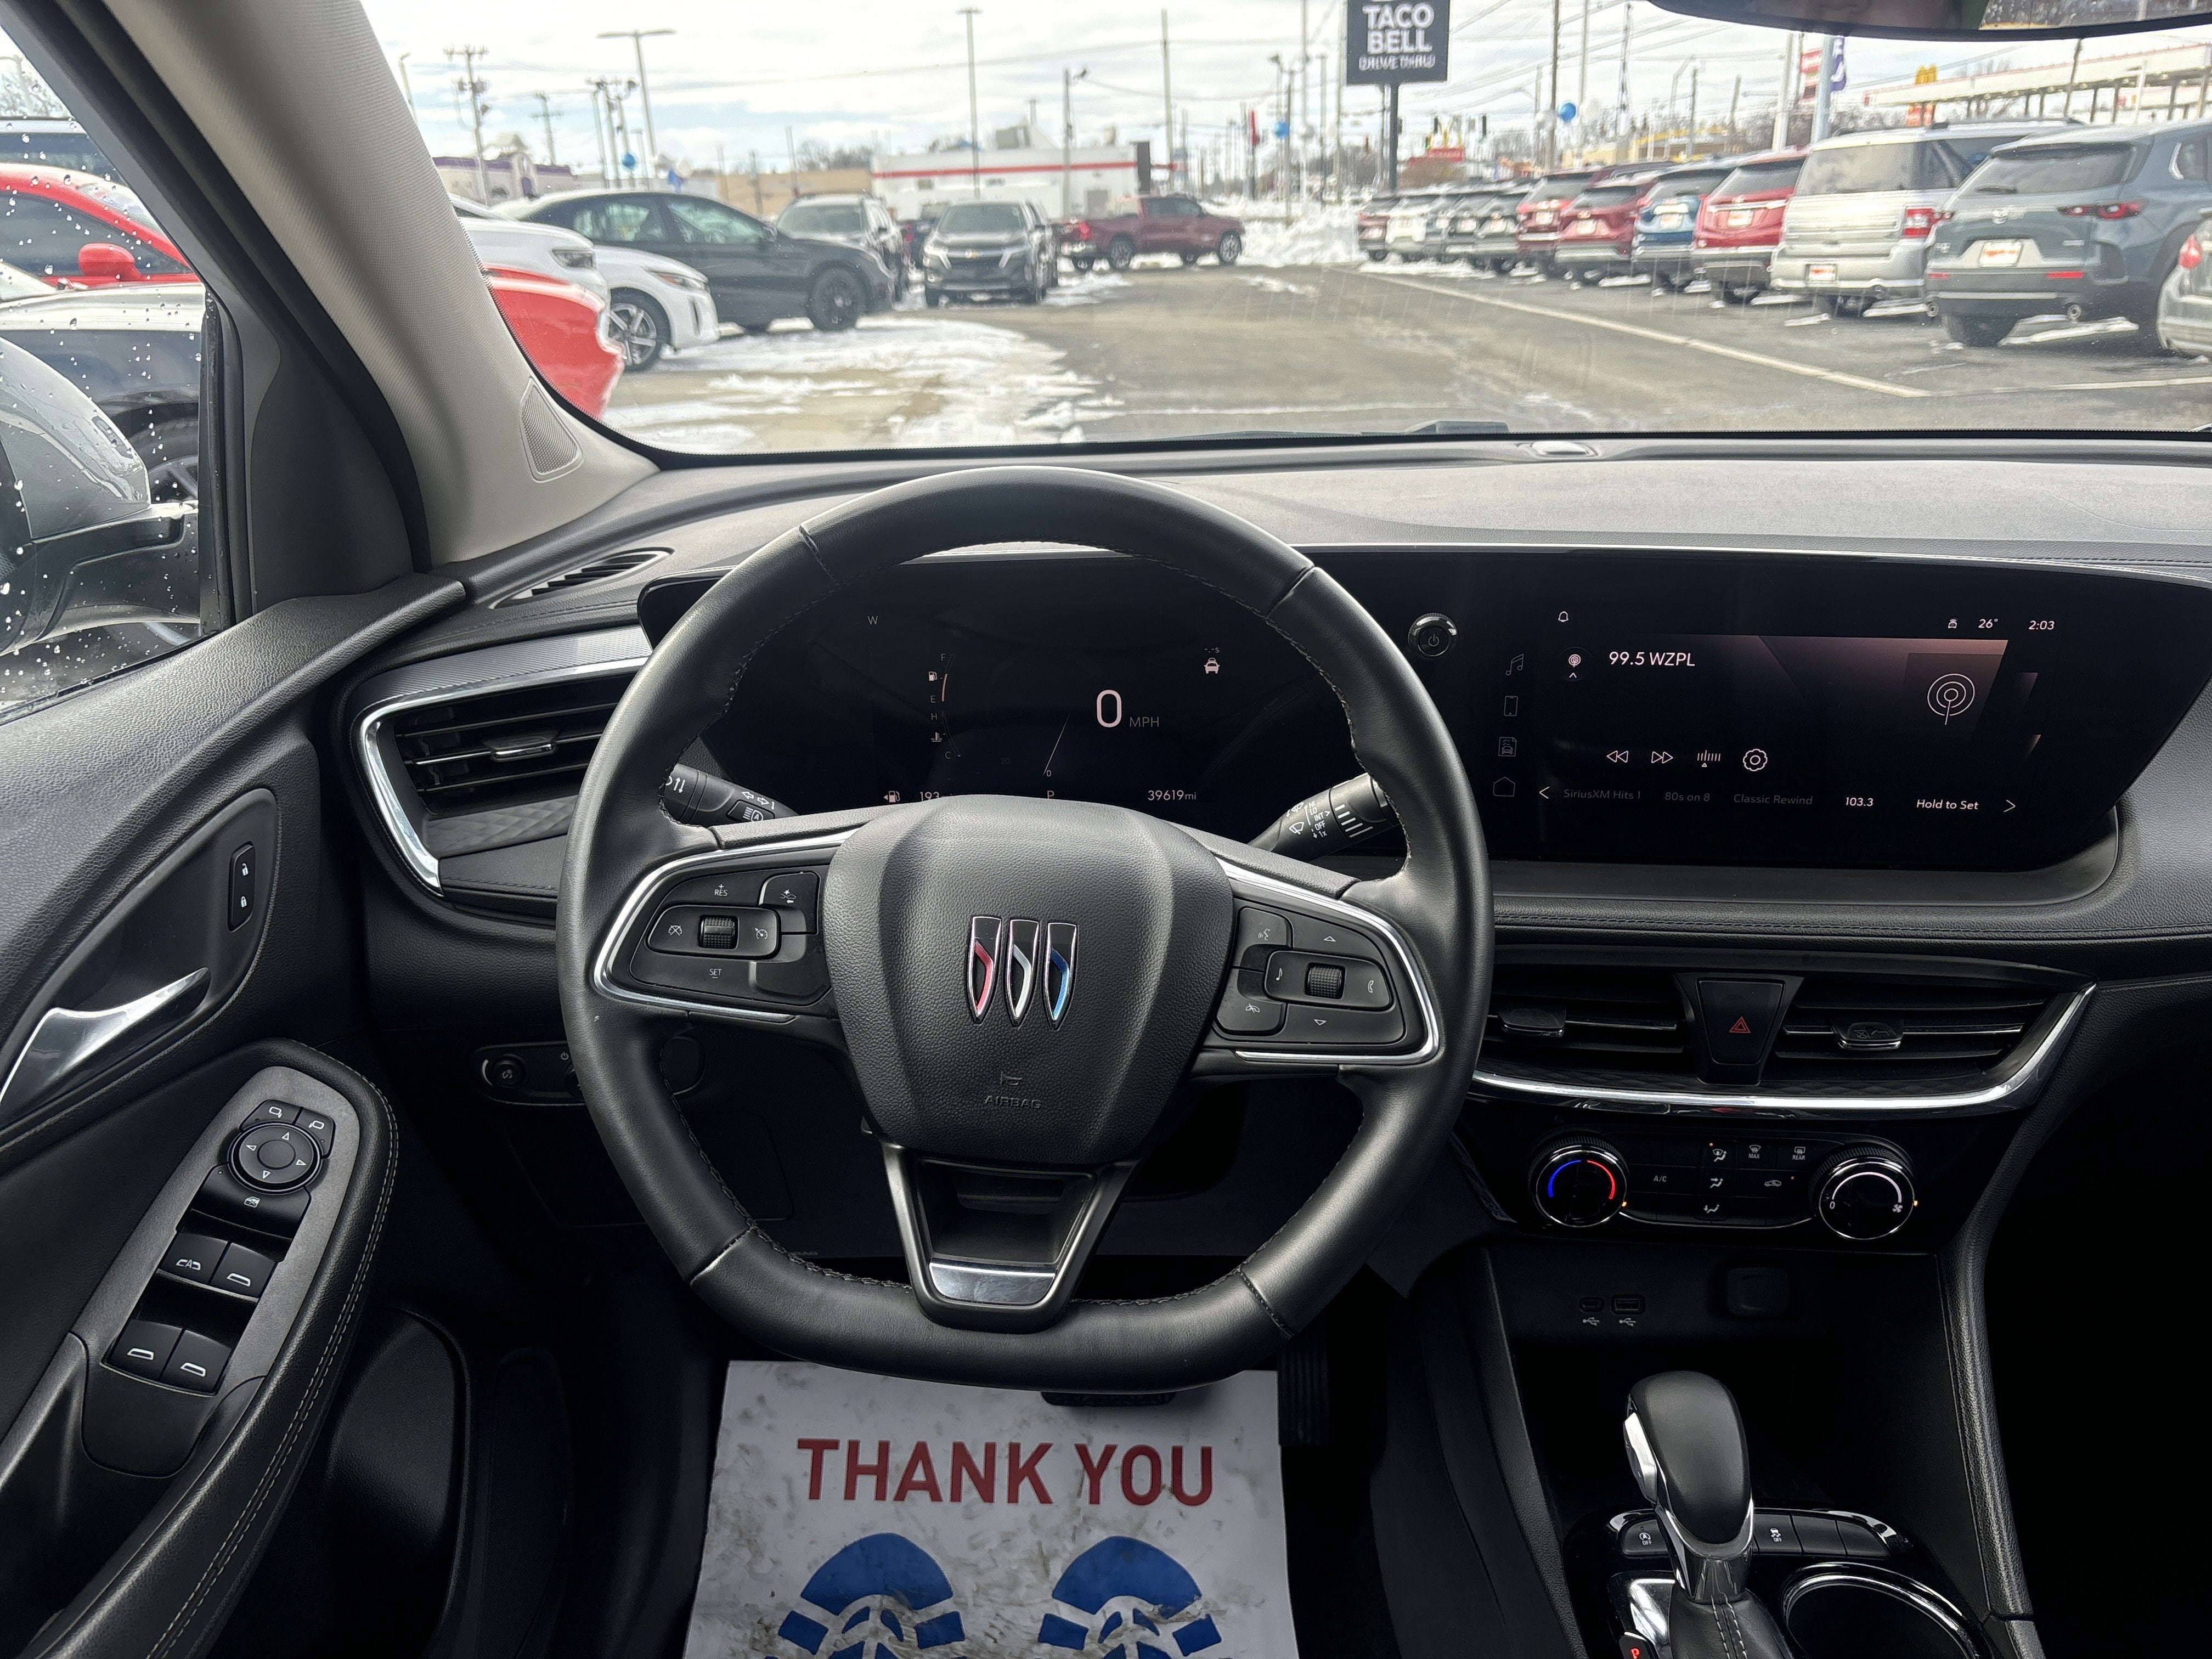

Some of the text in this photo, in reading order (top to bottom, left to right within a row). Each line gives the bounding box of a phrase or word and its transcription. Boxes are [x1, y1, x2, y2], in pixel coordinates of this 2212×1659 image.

[1362, 3, 1435, 29] TACO
[1367, 28, 1433, 54] BELL
[867, 616, 879, 625] W
[2028, 620, 2055, 630] 2:03
[1609, 651, 1696, 667] 99.5 WZPL
[1095, 689, 1160, 729] 0 MPH
[1147, 790, 1197, 802] 39619mi
[1563, 789, 1611, 799] SiriusXM
[1613, 789, 1634, 800] Hits
[1664, 792, 1711, 802] 80s on 8
[1733, 793, 1813, 805] Classic Rewind
[1844, 796, 1874, 808] 103.3
[1916, 799, 1979, 811] Hold to Set
[1313, 812, 1324, 822] INT
[1314, 821, 1326, 831] OFF
[714, 889, 728, 897] RES
[983, 1095, 1042, 1109] AIRBAG
[797, 1438, 1214, 1508] THANK YOU
